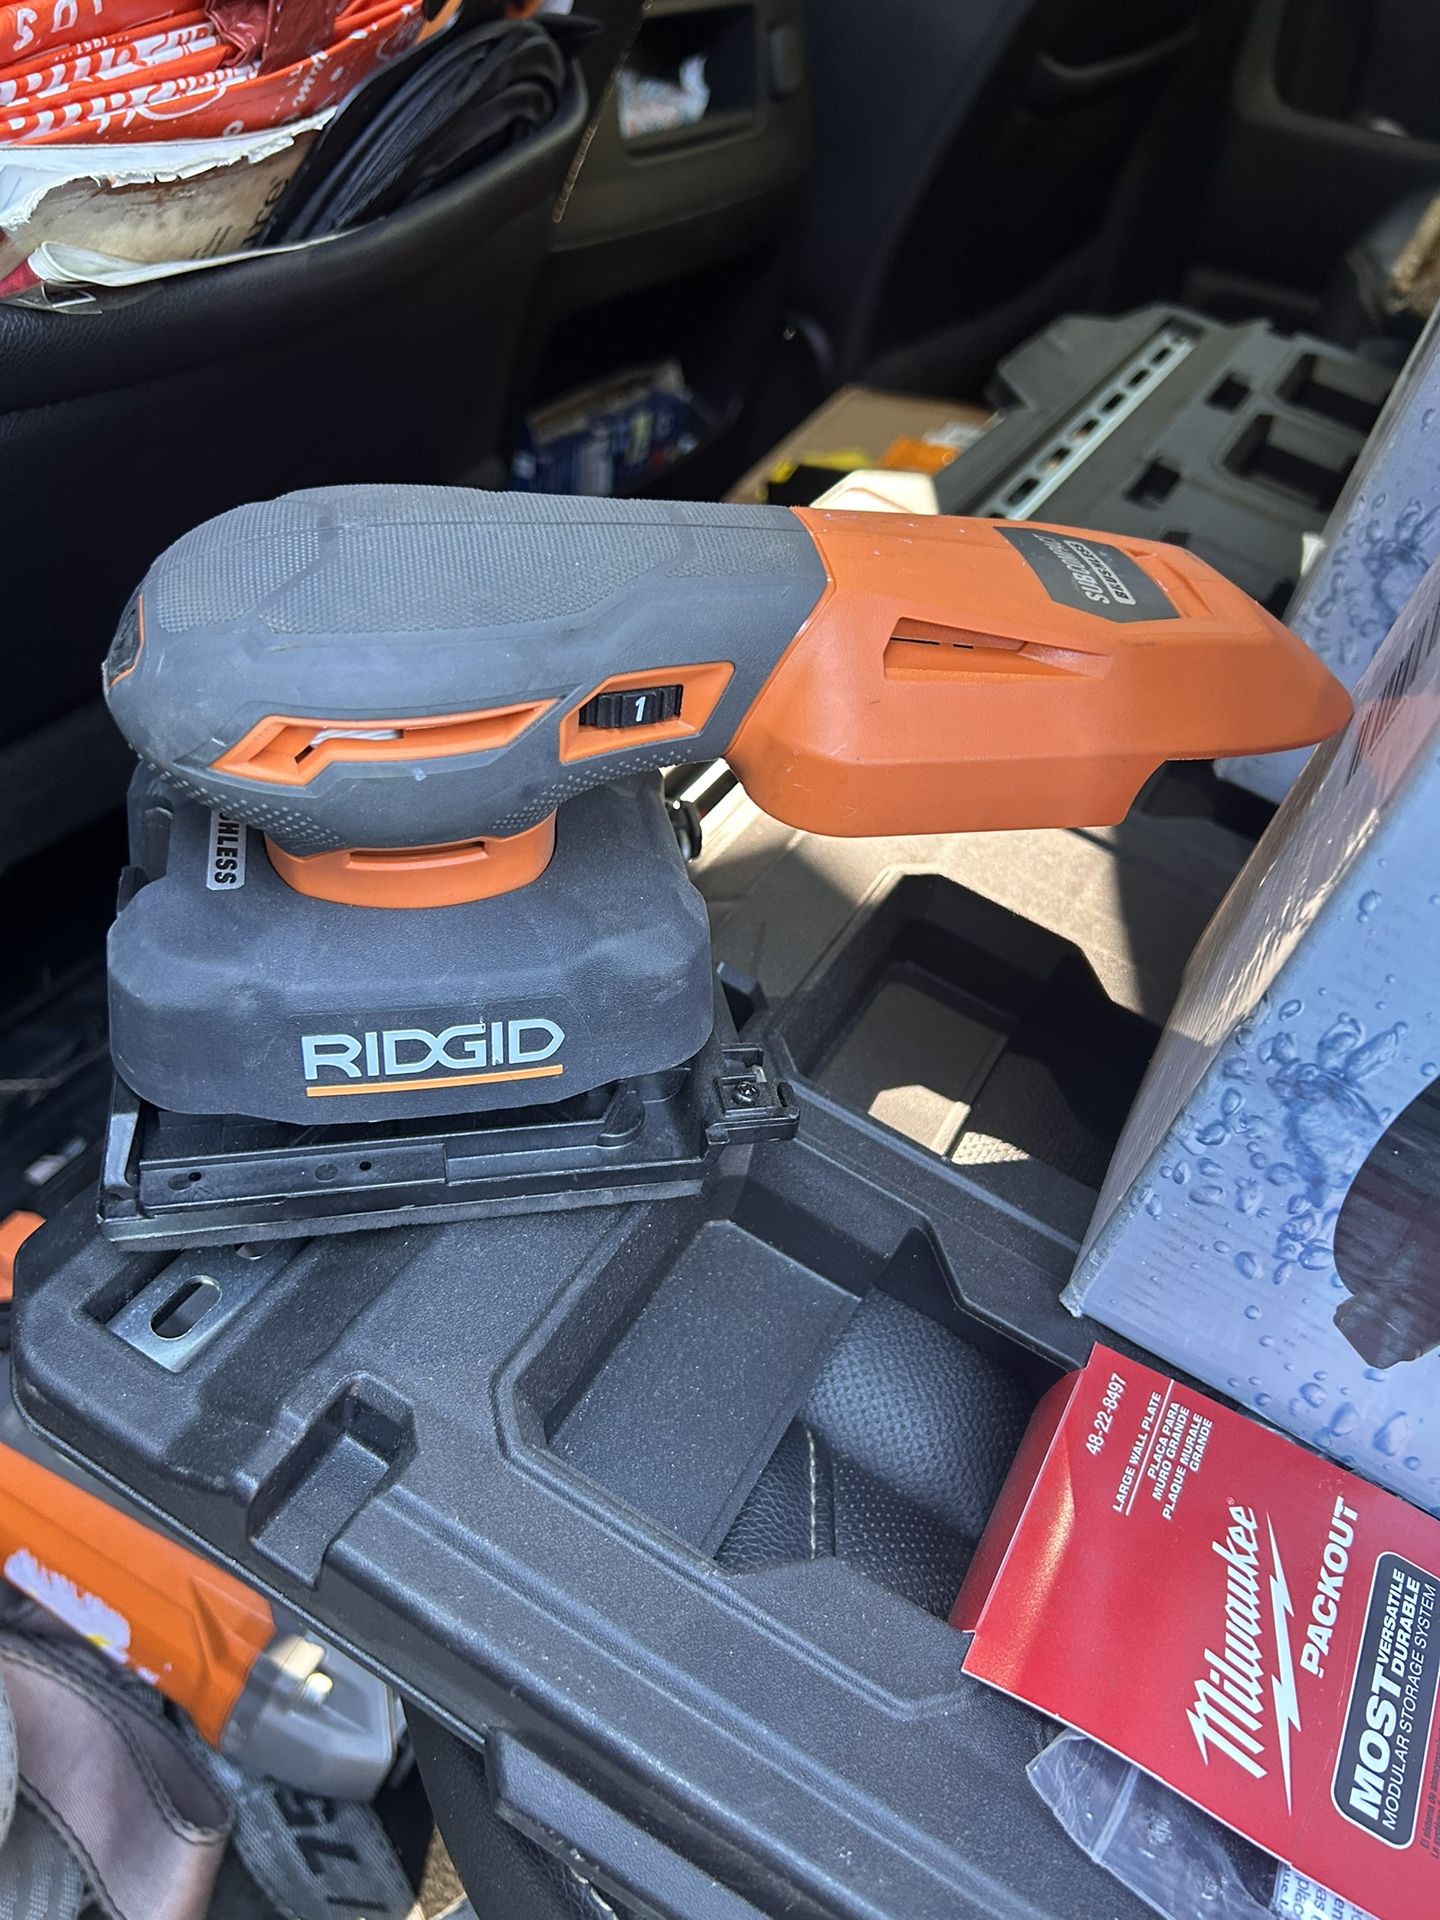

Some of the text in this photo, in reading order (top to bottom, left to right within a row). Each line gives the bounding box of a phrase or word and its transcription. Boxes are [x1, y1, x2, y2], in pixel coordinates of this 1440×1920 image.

[635, 695, 647, 723] 1
[301, 1018, 566, 1081] RIDGID
[1086, 1373, 1127, 1456] 48-22-8497
[1112, 1391, 1162, 1513] LARGE WALL PLATE
[1147, 1402, 1181, 1480] PLACA PARA
[1152, 1405, 1190, 1501] MURO GRANDE
[1189, 1417, 1213, 1472] GRANDE
[1162, 1413, 1203, 1521] PLAQUE MURALE
[1300, 1495, 1358, 1679] PACKOUT
[1391, 1576, 1420, 1677] DURABLE
[1186, 1505, 1268, 1780] Milwaukee
[1350, 1568, 1405, 1820] MOST VERSATILE
[1381, 1583, 1437, 1831] MODULAR STORAGE SYSTEM
